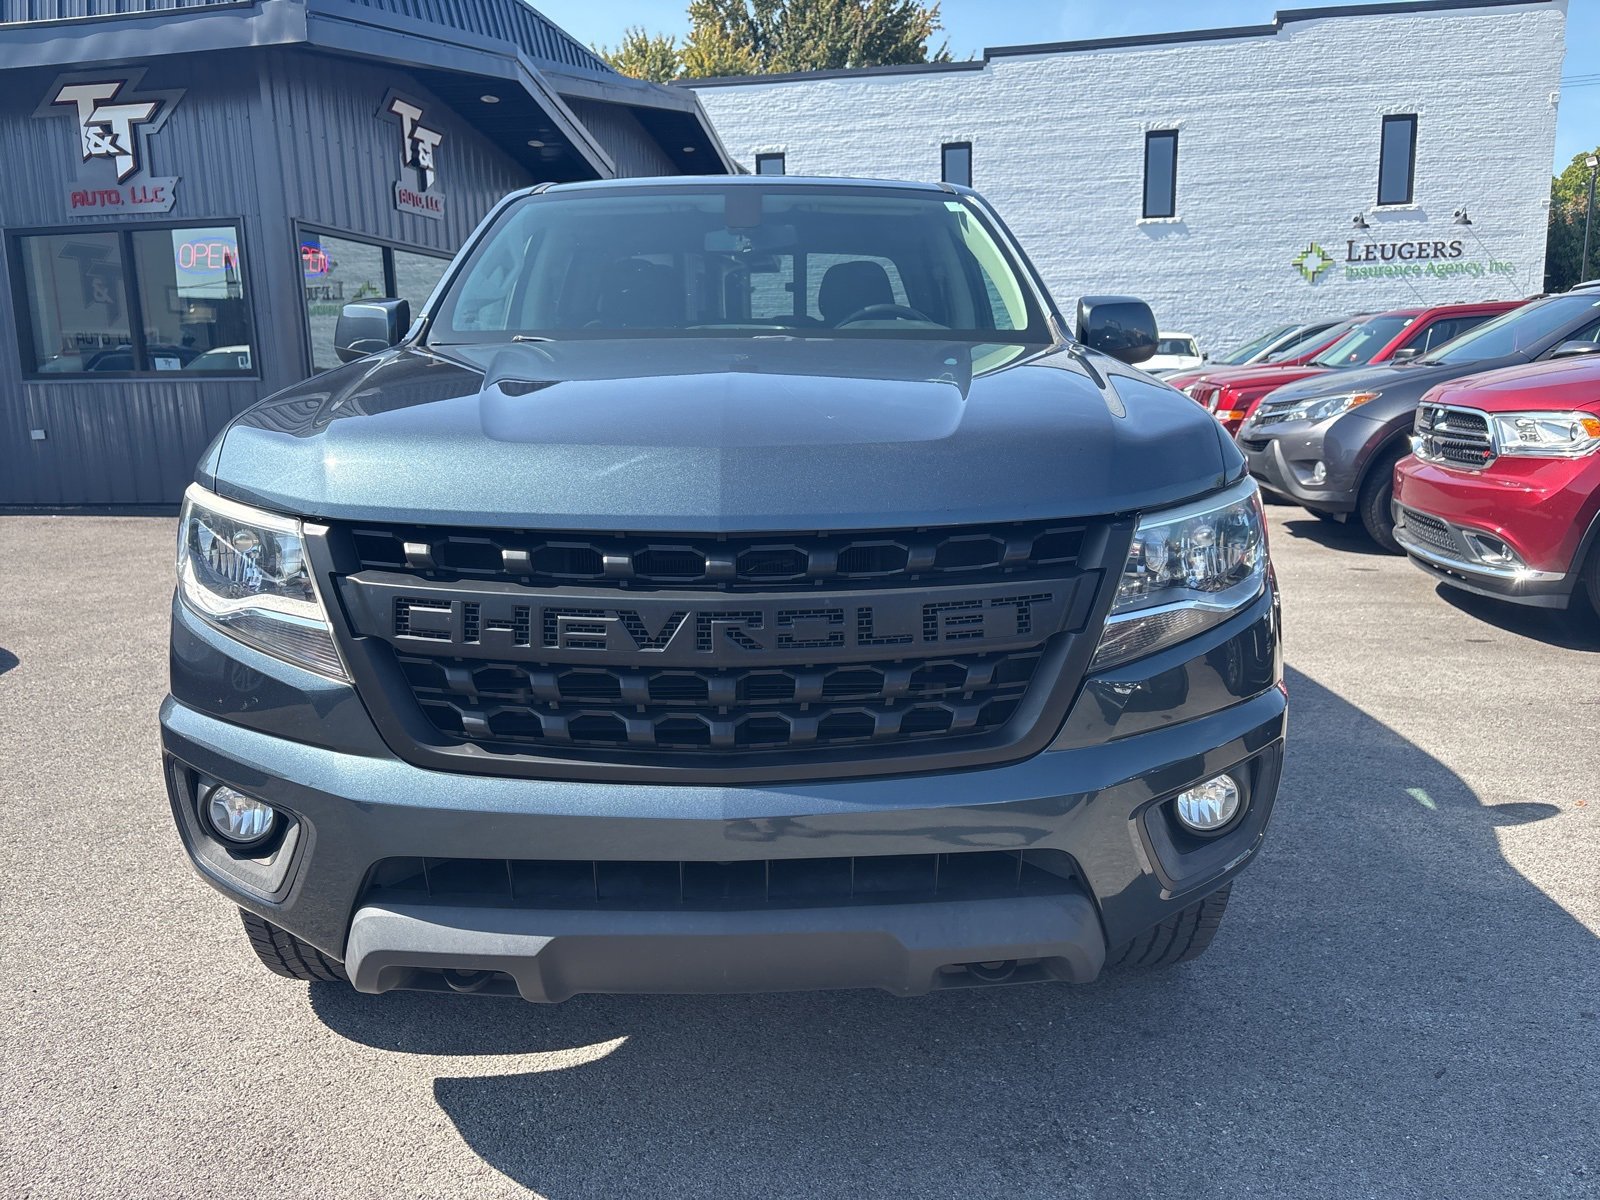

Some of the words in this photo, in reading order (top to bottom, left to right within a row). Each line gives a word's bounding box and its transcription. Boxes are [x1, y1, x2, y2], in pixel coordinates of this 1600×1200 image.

[52, 80, 160, 184] T&T
[71, 188, 125, 208] AUTO,
[130, 186, 166, 205] LLC
[178, 243, 238, 269] OPEN
[301, 246, 328, 272] PEN
[1345, 239, 1463, 262] LEUGERS
[393, 593, 1053, 653] CHEVROLET
